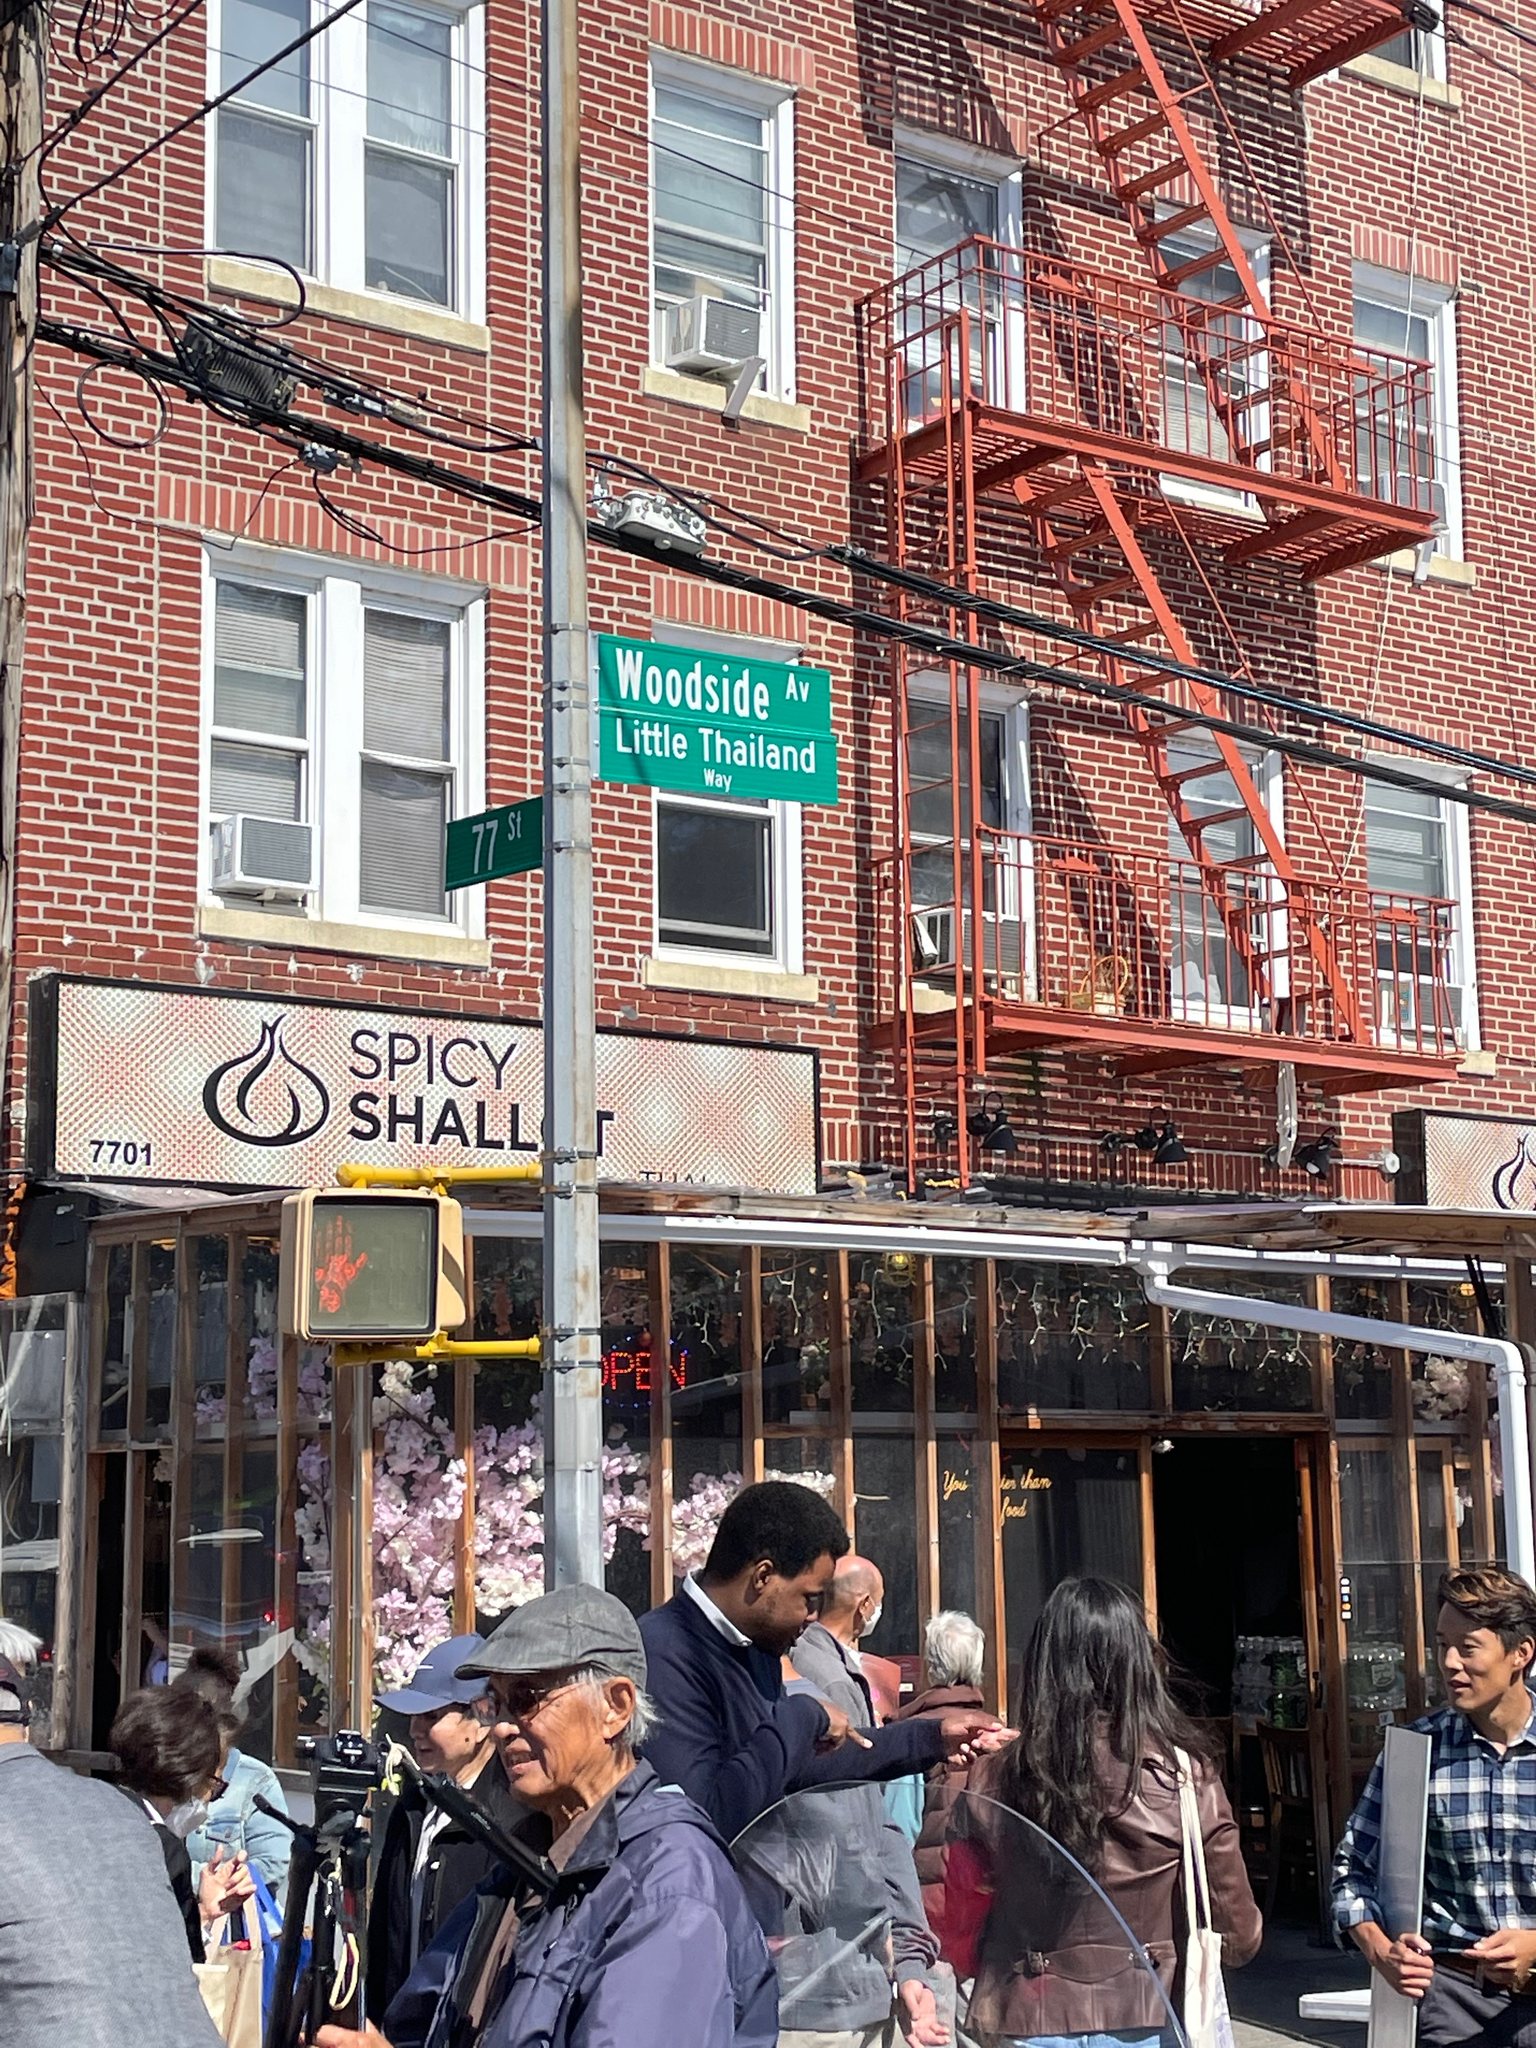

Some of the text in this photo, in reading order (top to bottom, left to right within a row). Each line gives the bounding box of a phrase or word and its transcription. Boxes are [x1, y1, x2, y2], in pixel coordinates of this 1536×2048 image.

[615, 647, 810, 721] Woodside Av
[616, 718, 817, 774] Little Thailand
[703, 768, 732, 793] Way
[472, 810, 522, 875] 77 St
[349, 1029, 518, 1090] SPICY
[349, 1091, 615, 1157] SHALLT
[89, 1140, 152, 1167] 7701
[1020, 1468, 1053, 1490] than
[1000, 1496, 1028, 1527] food
